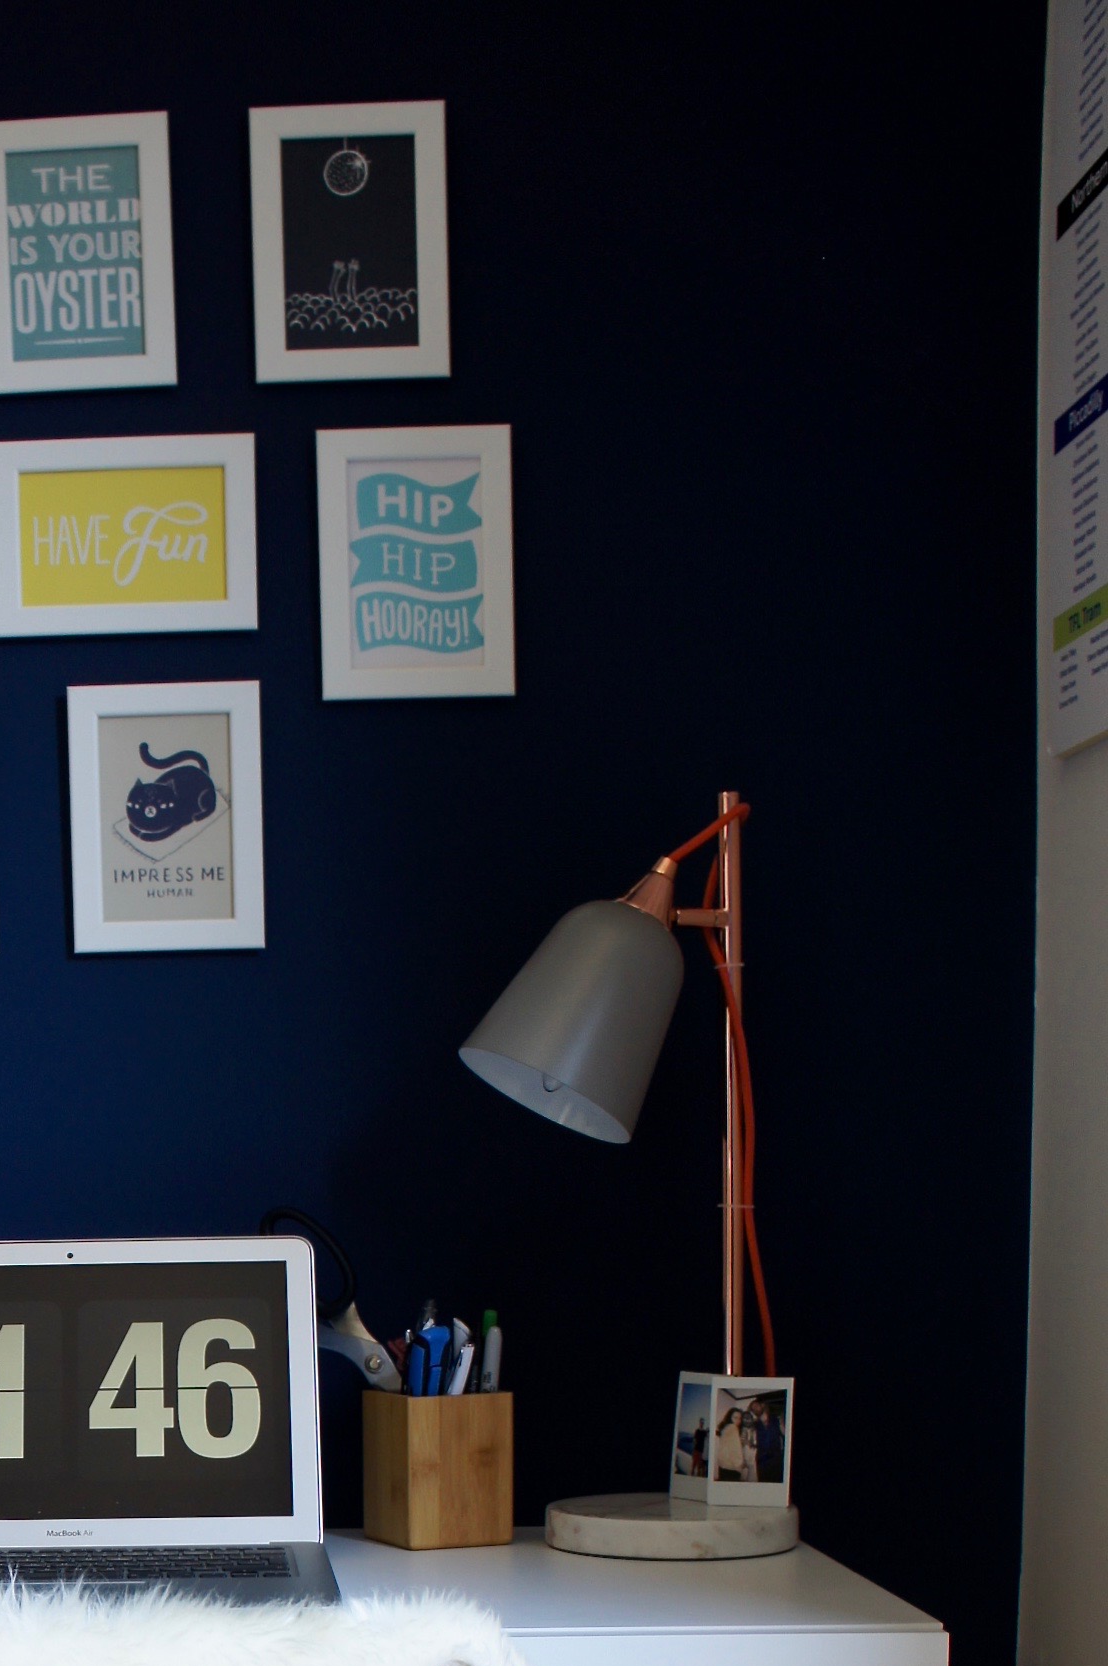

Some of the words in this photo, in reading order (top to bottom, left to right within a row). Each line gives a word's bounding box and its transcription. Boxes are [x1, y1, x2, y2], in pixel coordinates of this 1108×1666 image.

[32, 164, 112, 194] THE
[7, 198, 140, 229] WORLD
[9, 236, 38, 266] IS
[47, 231, 142, 263] YOUR
[14, 267, 141, 334] OYSTER
[377, 483, 454, 528] HIP
[33, 514, 110, 566] HAVE
[113, 501, 208, 587] Fun
[381, 542, 456, 585] HIP
[361, 598, 470, 647] HOORAY!
[113, 867, 193, 883] IMPRESS
[201, 866, 225, 881] ME
[147, 888, 193, 898] HUMAN
[88, 1318, 261, 1459] 46
[46, 1529, 81, 1537] MacBook
